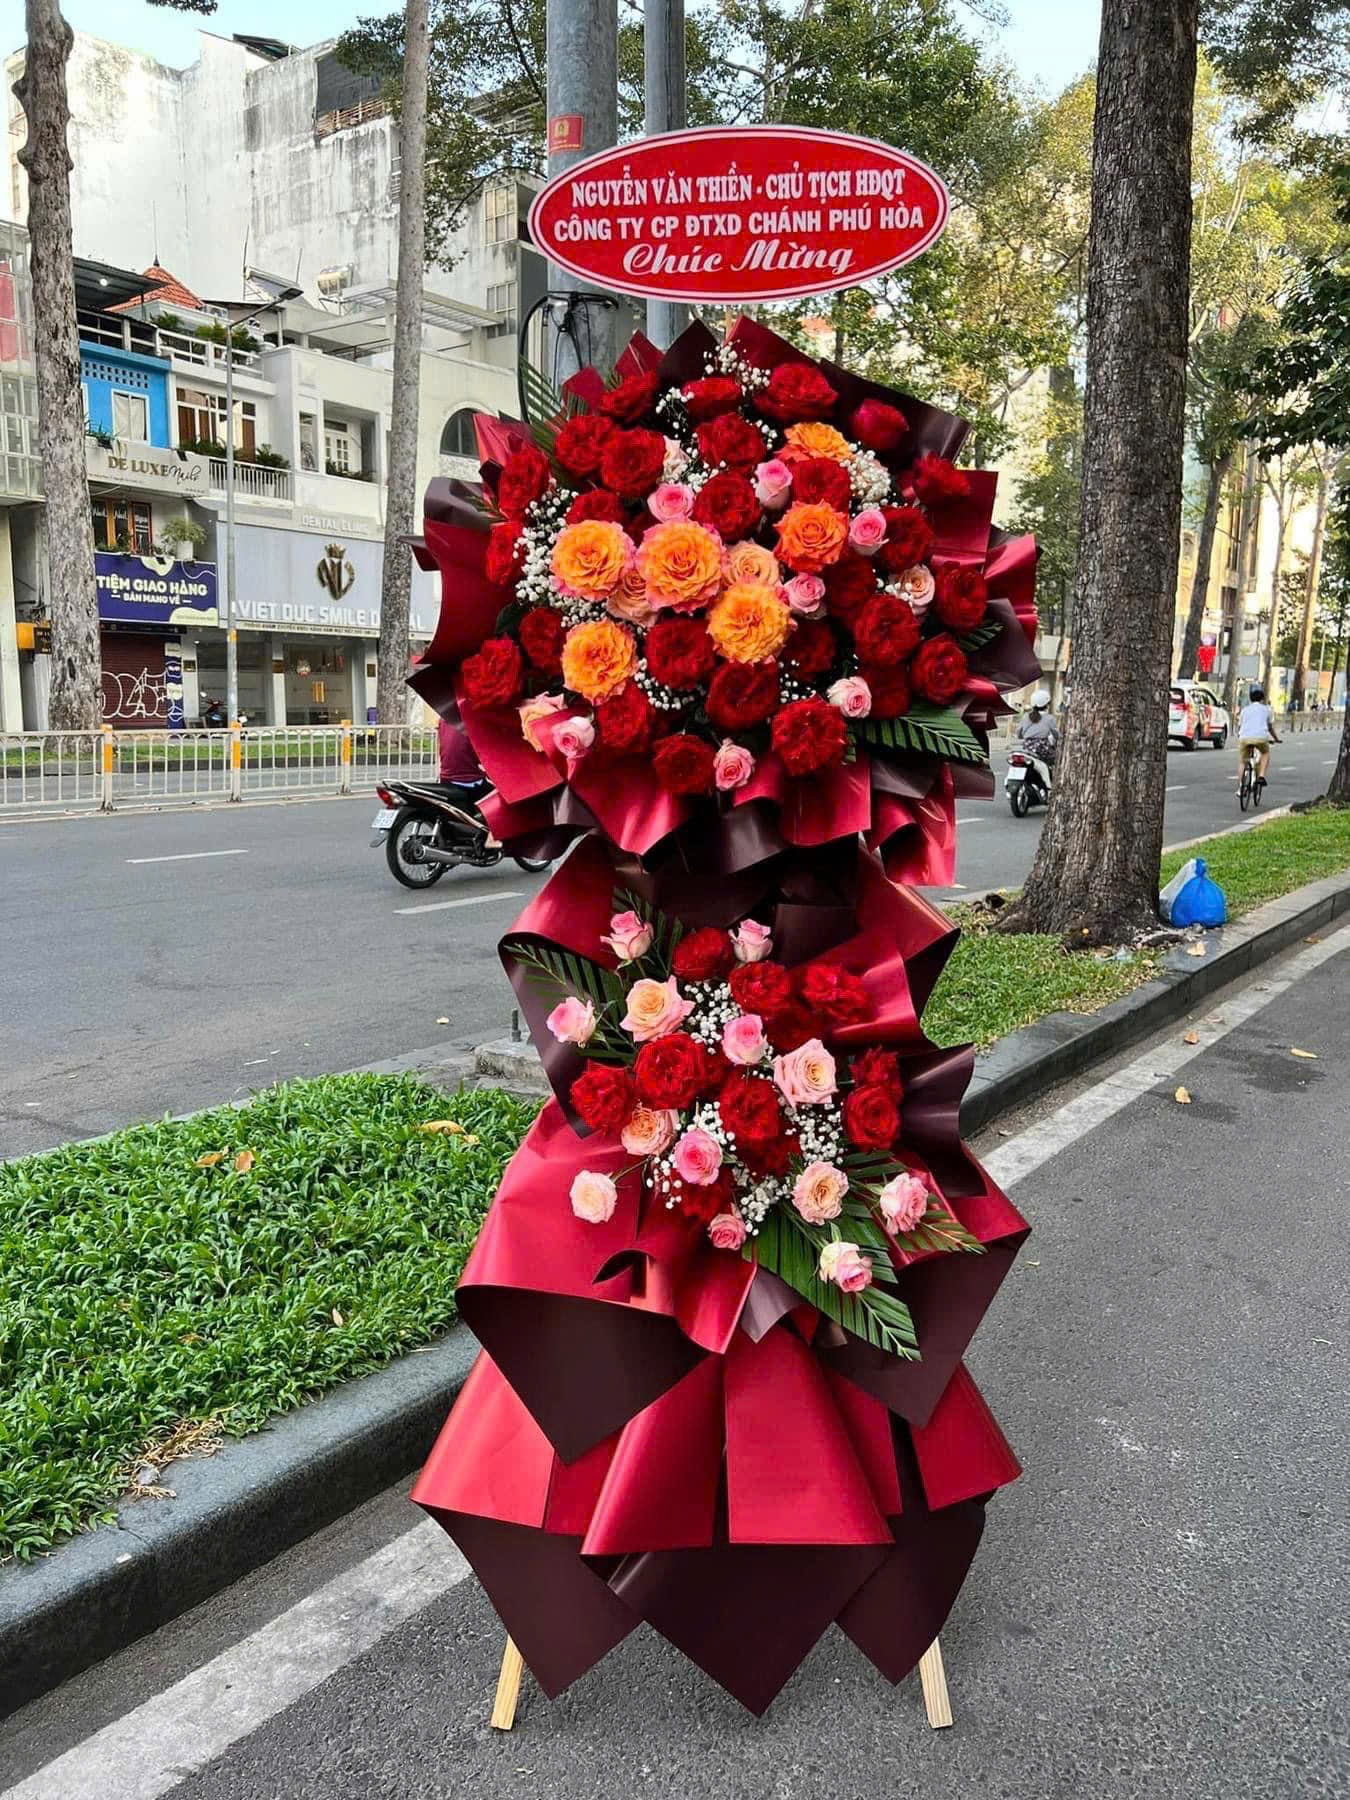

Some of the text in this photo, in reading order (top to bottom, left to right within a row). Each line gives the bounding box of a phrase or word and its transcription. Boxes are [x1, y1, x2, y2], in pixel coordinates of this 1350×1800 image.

[572, 165, 648, 208] NGUYỄN
[652, 170, 692, 204] VĂN
[696, 161, 752, 203] THIỀN
[766, 161, 803, 200] CHỦ
[808, 170, 850, 205] TỊCH
[856, 168, 905, 201] HĐQT
[554, 201, 925, 242] CÔNG TY CP ĐTXD CHÁNH PHÚ HÒA
[623, 238, 856, 276] Chúc Mừng
[108, 456, 128, 471] DE
[131, 460, 169, 477] LUXE
[96, 573, 208, 596] TIỆM GIAO HÀNG
[320, 605, 367, 626] SMILE
